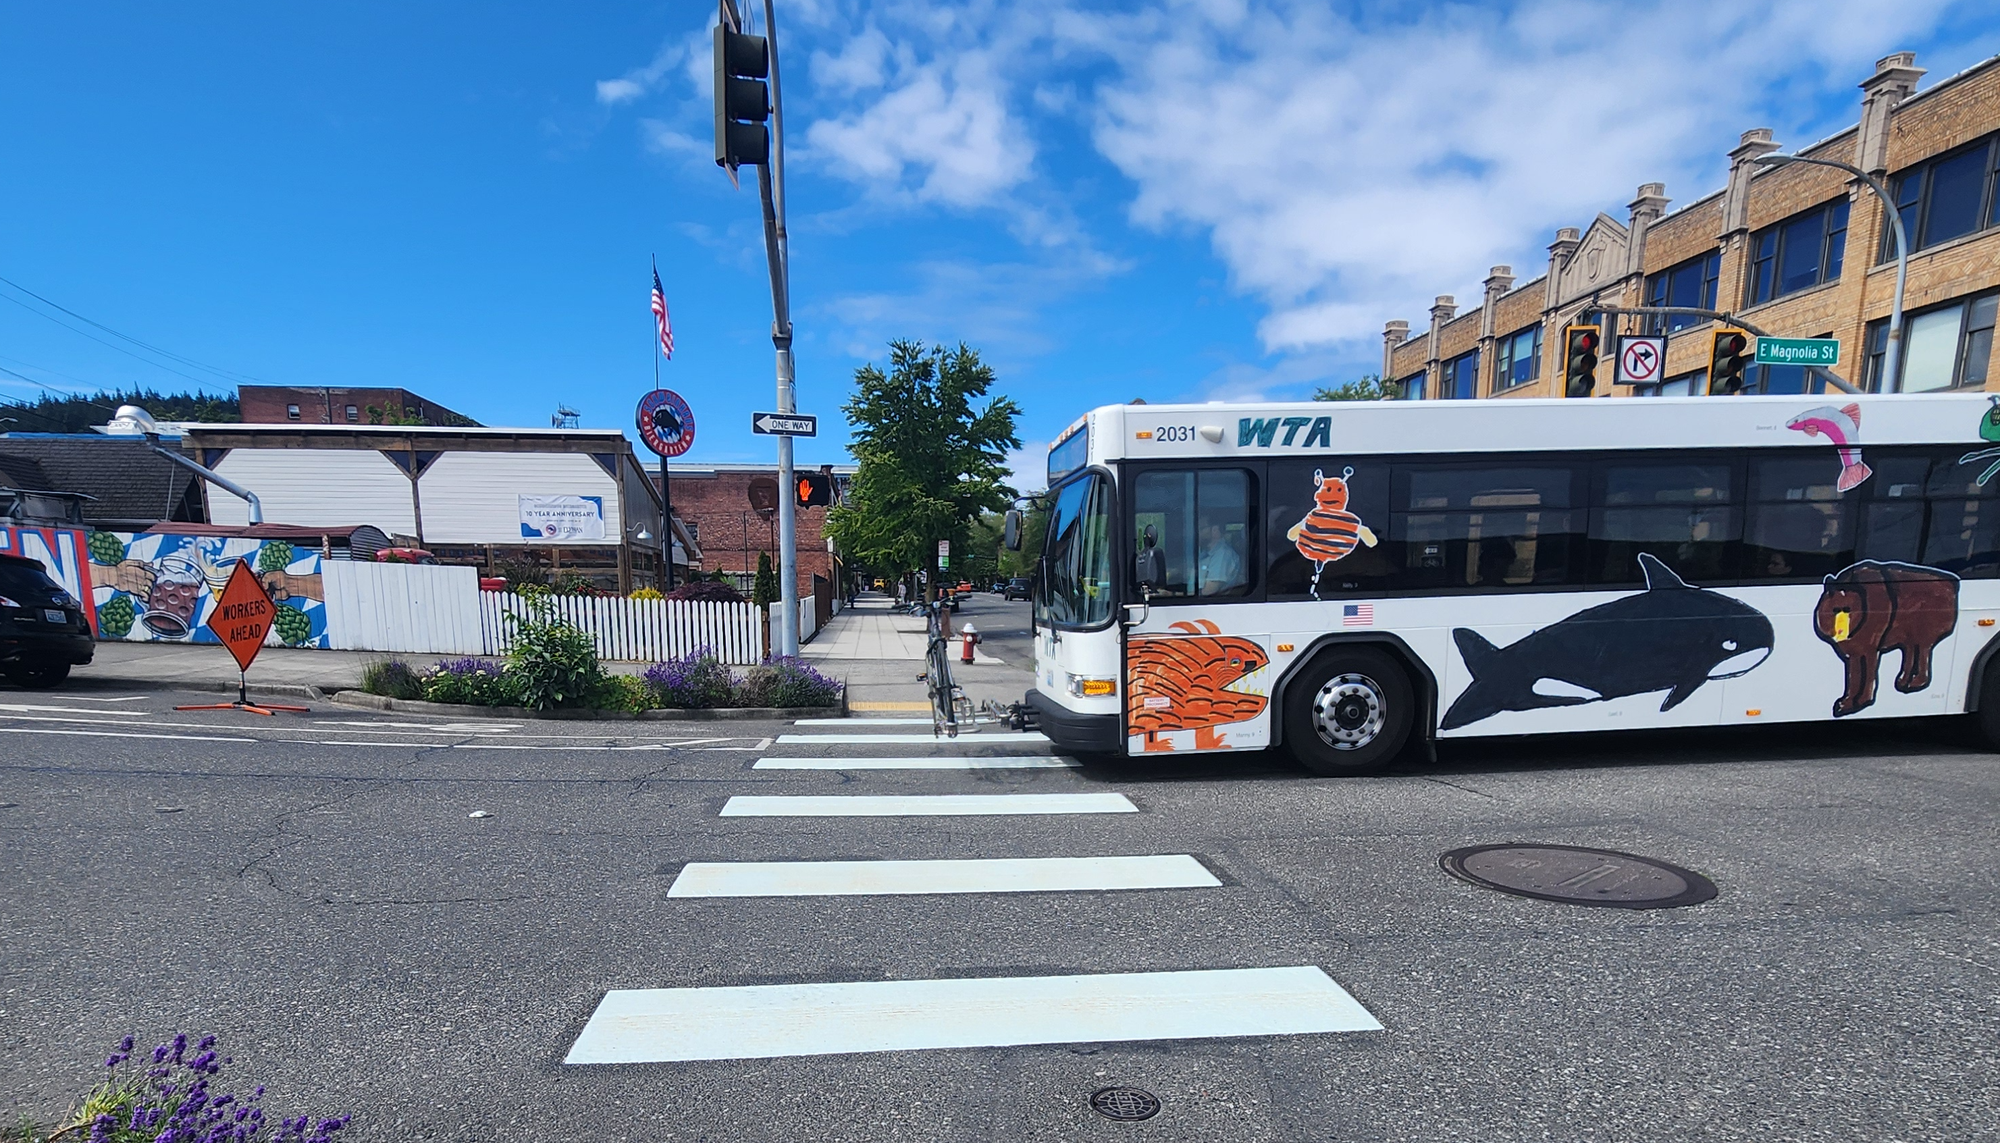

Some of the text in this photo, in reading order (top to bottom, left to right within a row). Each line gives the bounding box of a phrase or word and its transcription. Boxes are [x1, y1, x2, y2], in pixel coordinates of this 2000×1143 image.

[1760, 343, 1834, 362] E Magnolia St
[771, 419, 810, 431] ONE WAY
[1156, 426, 1196, 442] 2031
[1237, 416, 1332, 448] WTA
[643, 425, 688, 455] BIERGARTEN
[222, 599, 266, 621] WORKERS
[230, 623, 261, 643] AHEAD
